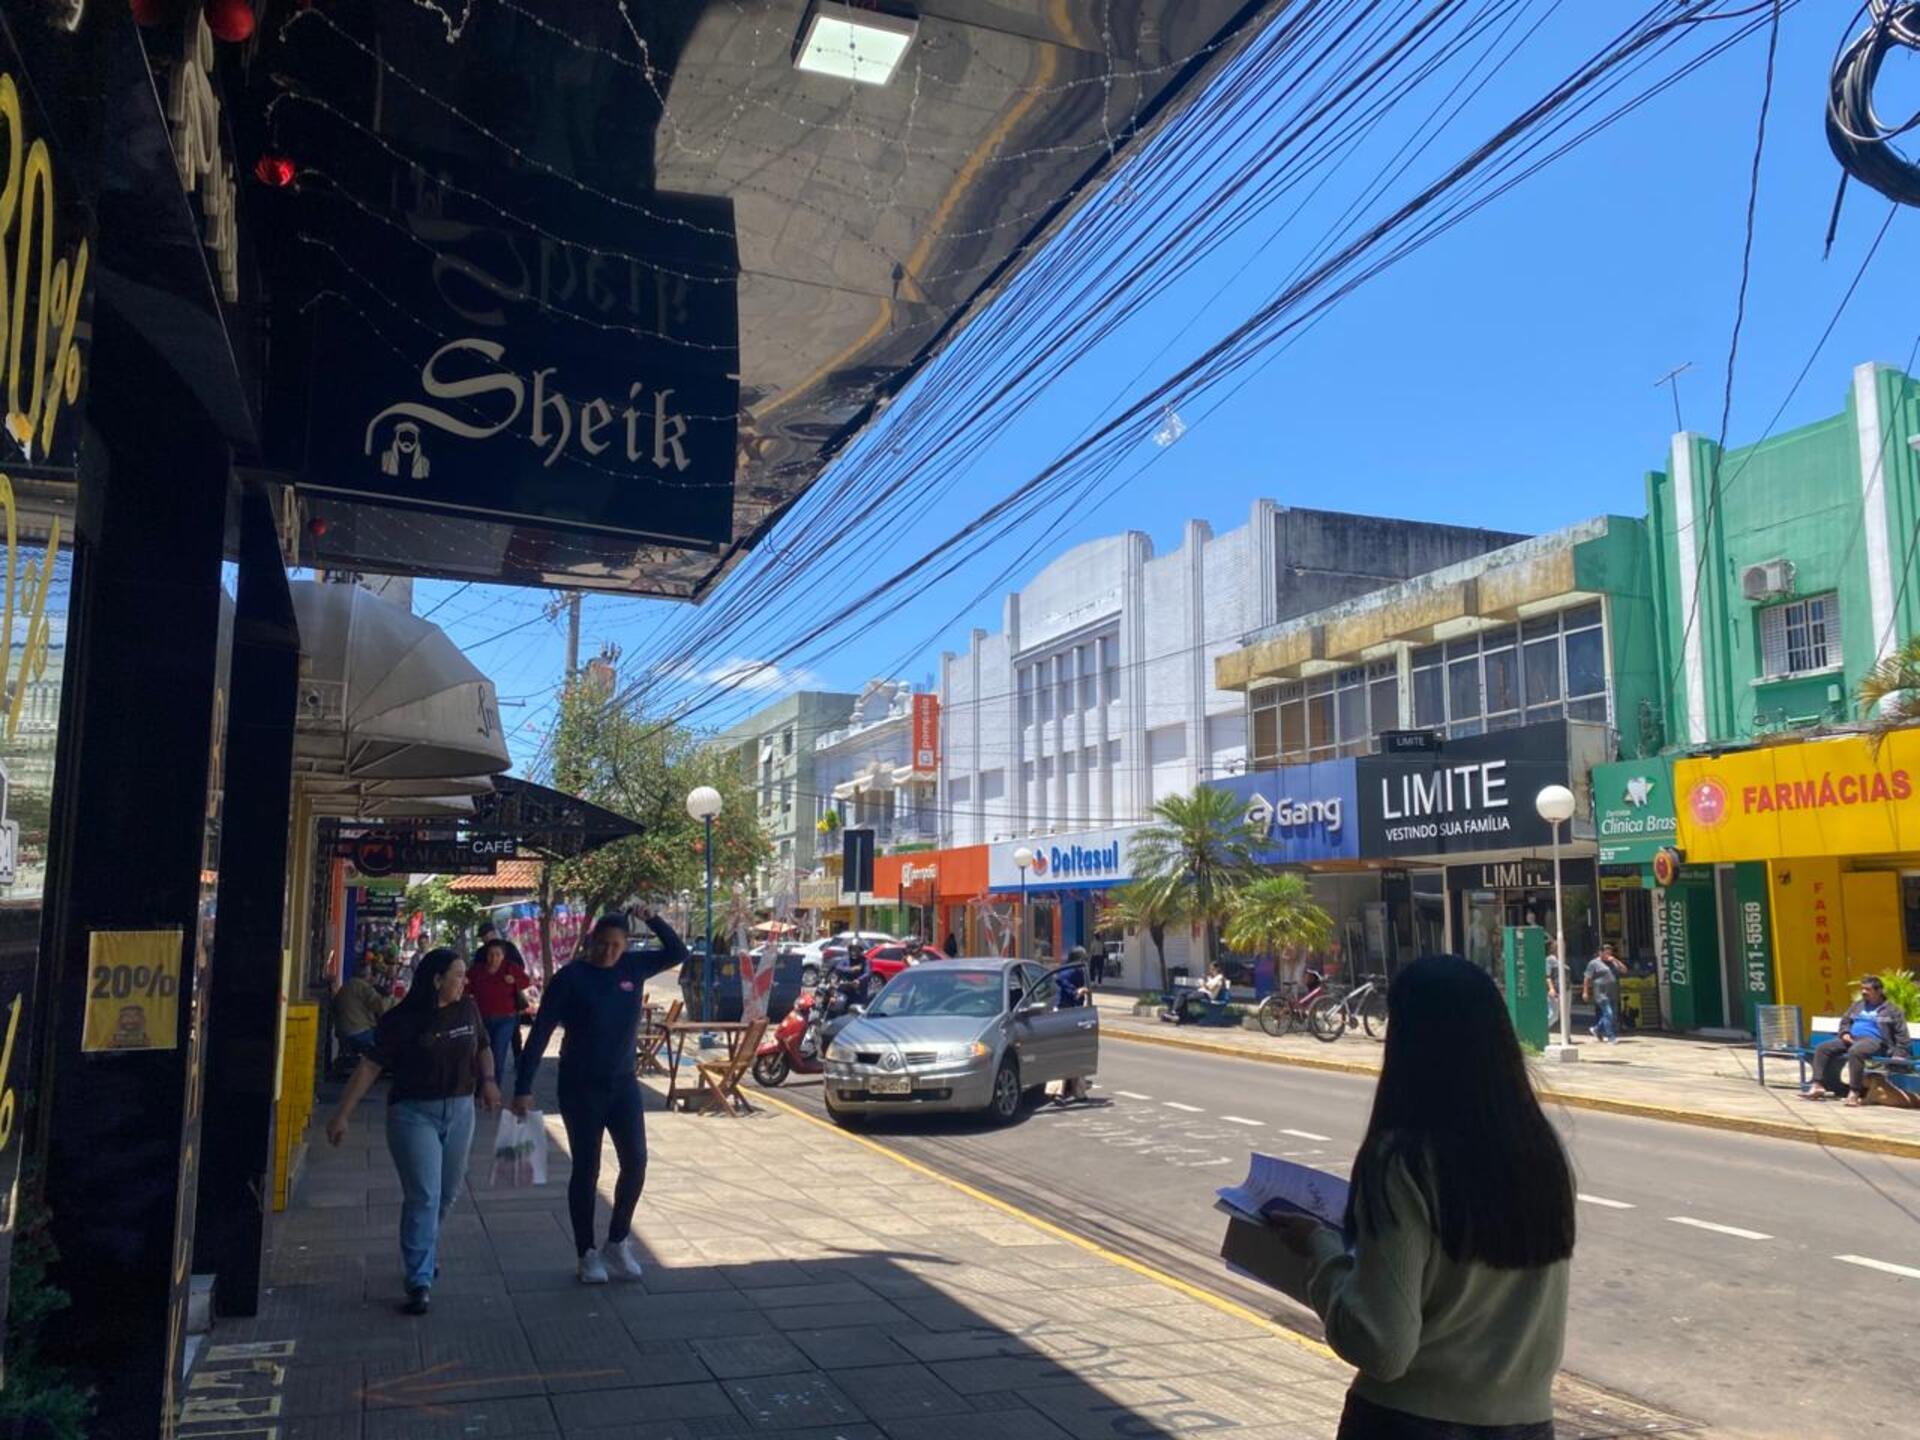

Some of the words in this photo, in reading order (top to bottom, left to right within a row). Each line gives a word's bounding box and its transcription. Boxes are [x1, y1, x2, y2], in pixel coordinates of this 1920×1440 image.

[364, 338, 691, 473] Sheik
[1382, 760, 1508, 820] LIMITE
[1743, 770, 1913, 815] FARMÁCIAS
[1276, 797, 1342, 831] Gang
[1385, 824, 1438, 842] VESTINDO
[1440, 820, 1464, 837] SUA
[1465, 815, 1510, 834] FAMÍLIA
[472, 840, 515, 855] CAFÉ
[1051, 840, 1118, 880] Deltasul
[1669, 901, 1686, 986] Dentistas
[1813, 882, 1835, 1013] FARMACIA
[92, 963, 177, 999] 20%
